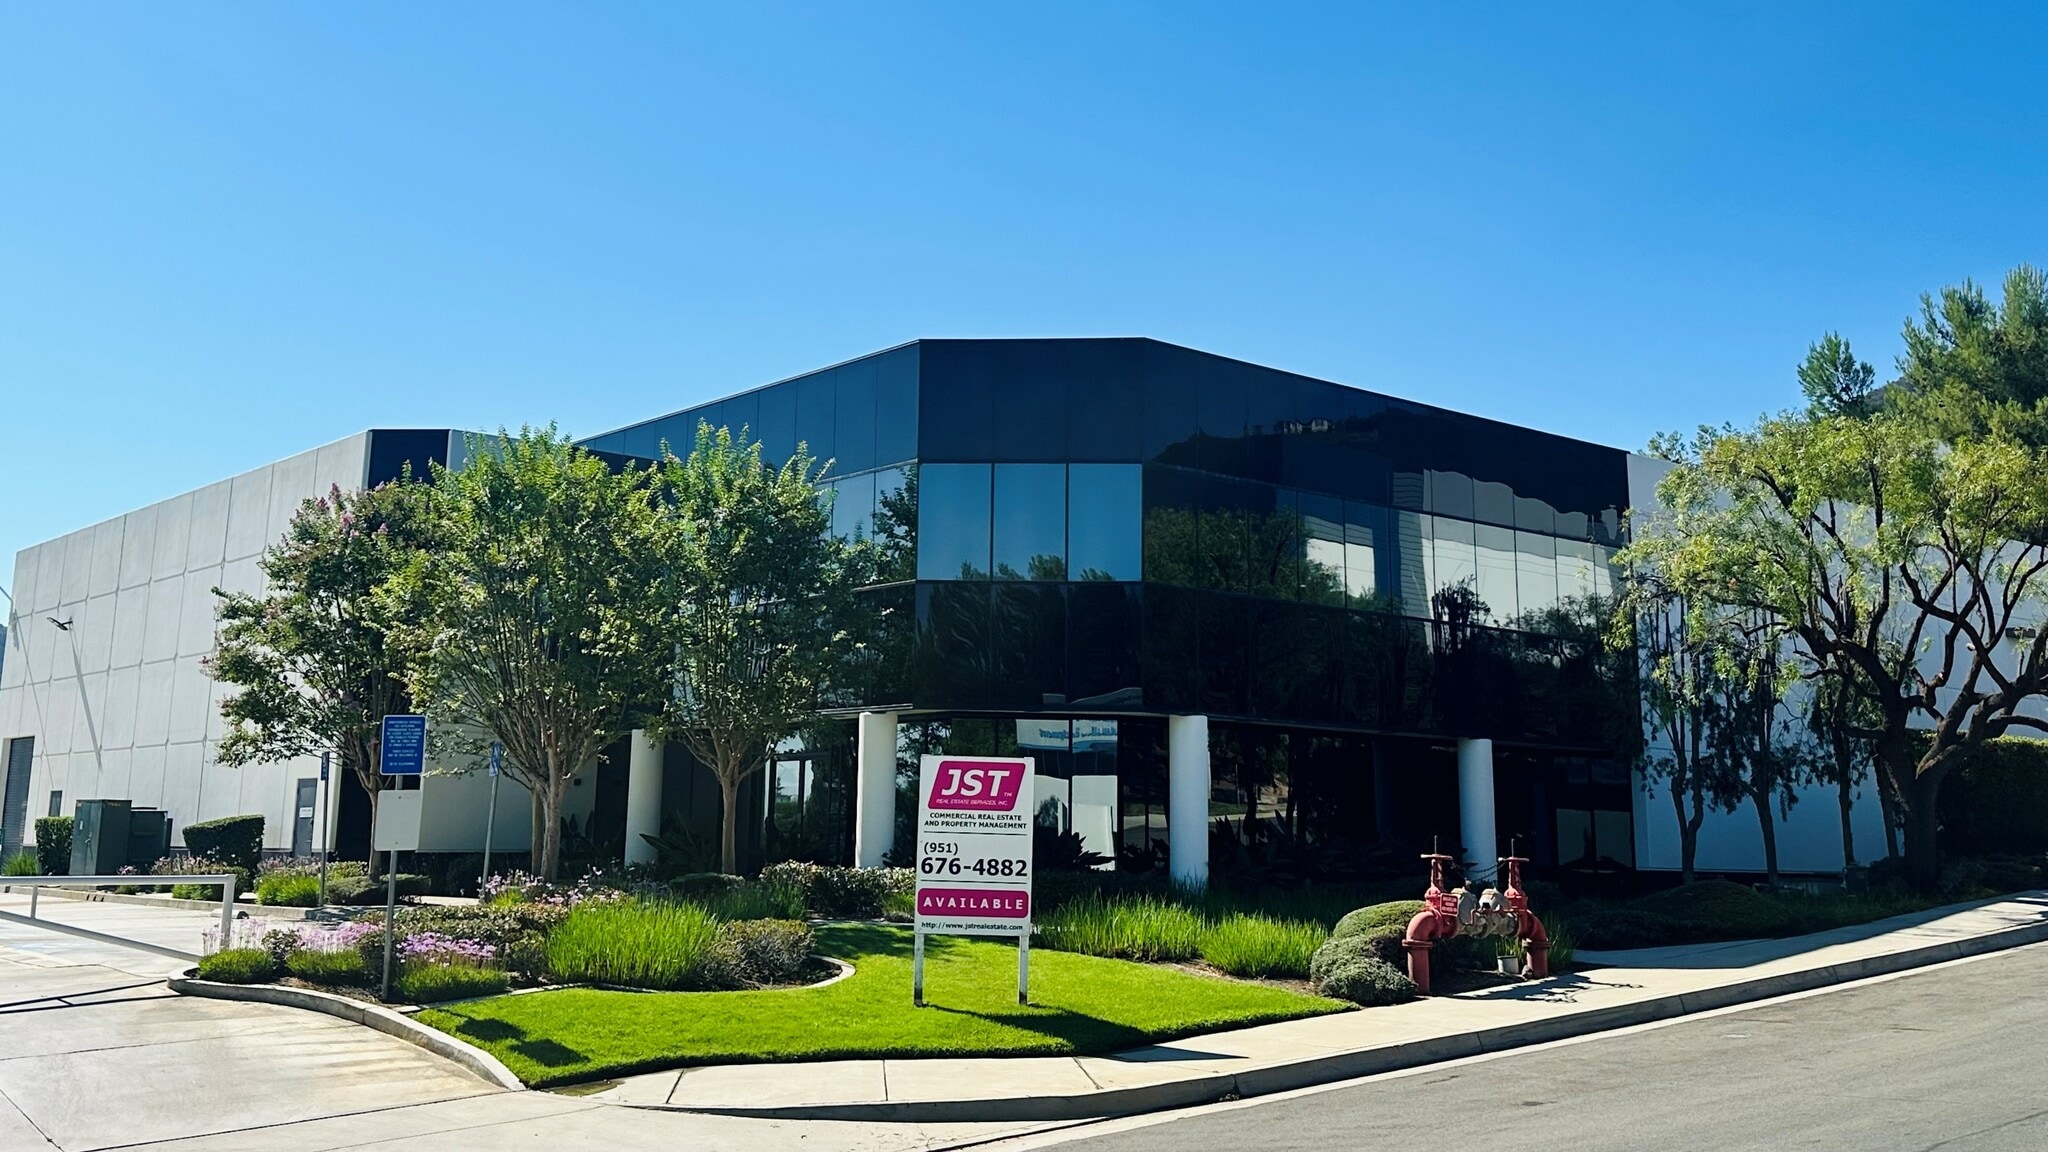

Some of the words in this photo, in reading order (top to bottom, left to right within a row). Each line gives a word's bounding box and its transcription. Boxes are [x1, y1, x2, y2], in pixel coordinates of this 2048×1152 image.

[941, 769, 1010, 797] JST
[930, 812, 975, 820] COMMERCIAL
[977, 813, 995, 821] REAL
[941, 820, 977, 828] PROPERTY
[978, 821, 1027, 829] MANAGEMENT
[924, 842, 958, 856] (951)
[921, 857, 1028, 877] 676-4882
[923, 896, 1023, 910] AVAILABLE
